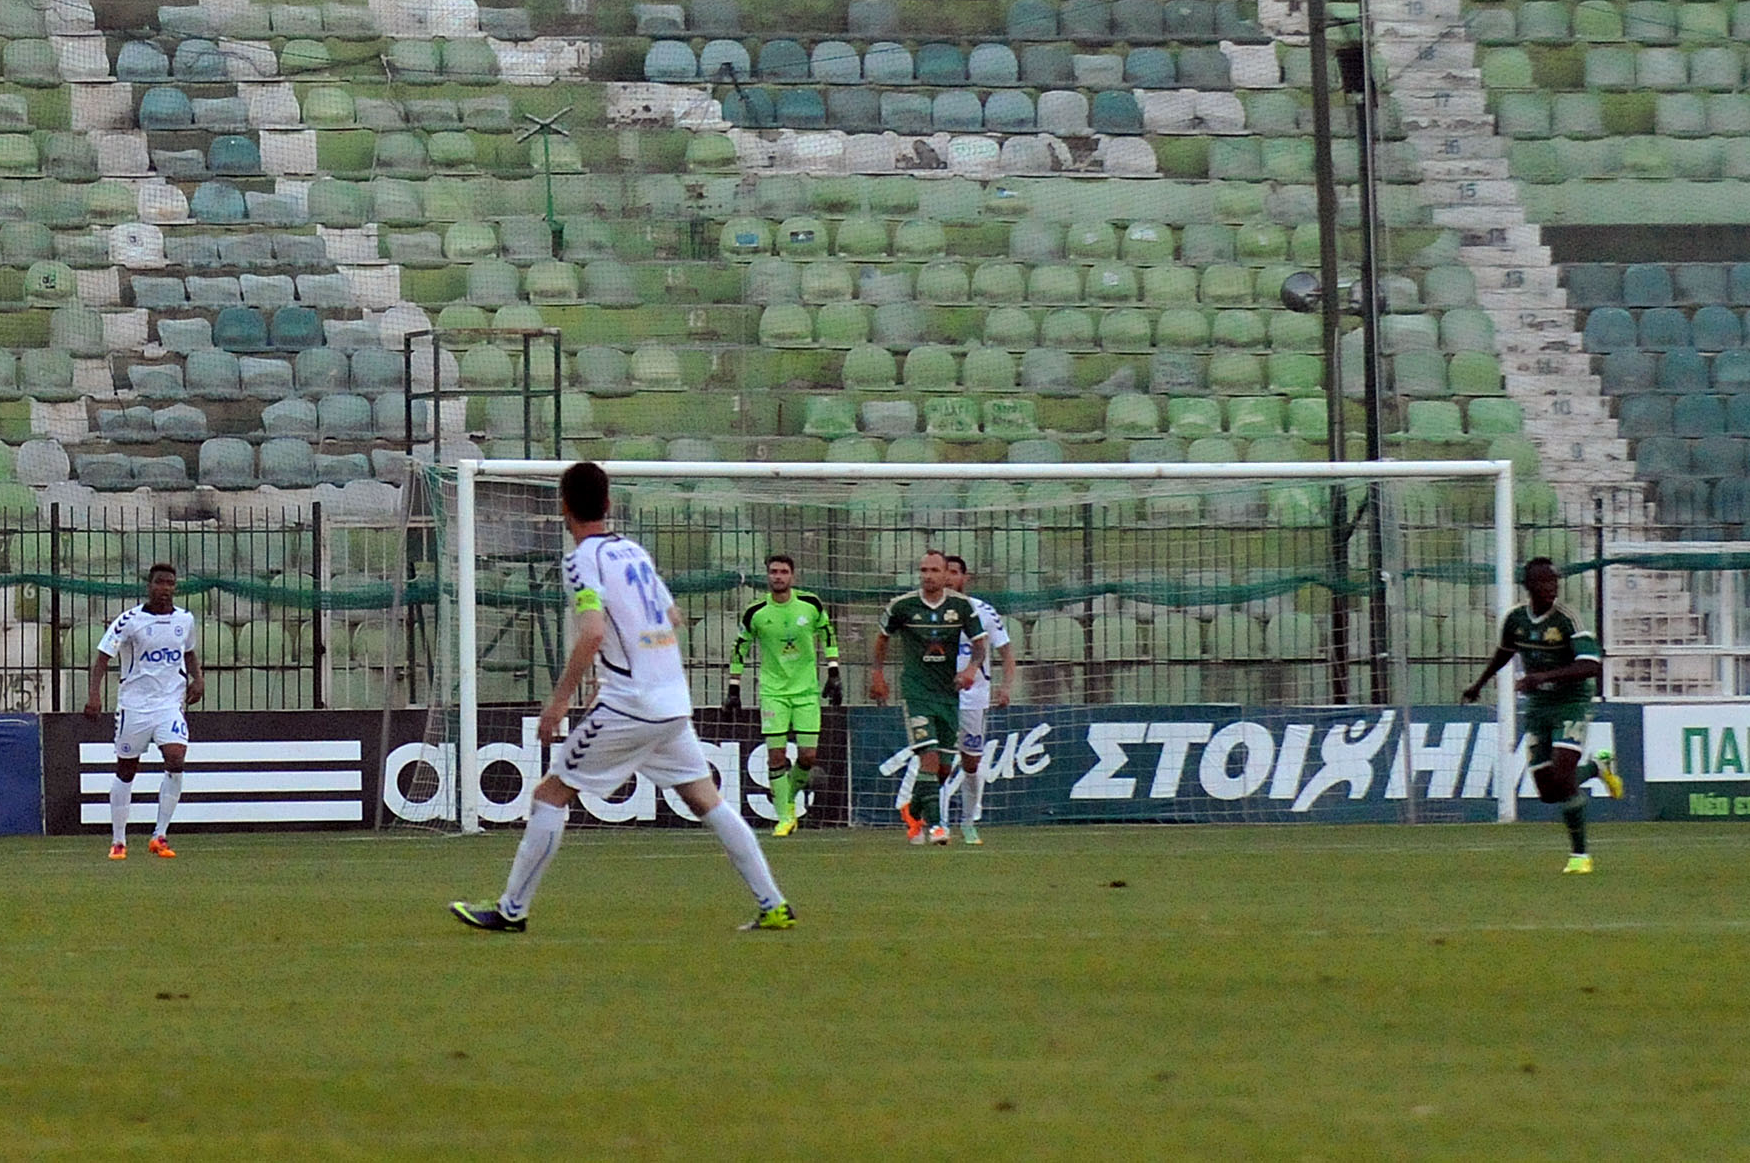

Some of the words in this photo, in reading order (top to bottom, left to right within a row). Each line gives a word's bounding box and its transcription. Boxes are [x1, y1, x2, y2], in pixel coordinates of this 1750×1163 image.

[23, 584, 35, 600] 6
[383, 717, 816, 823] adas
[879, 722, 1051, 821] Πμε
[1681, 726, 1750, 775] ΠΑ
